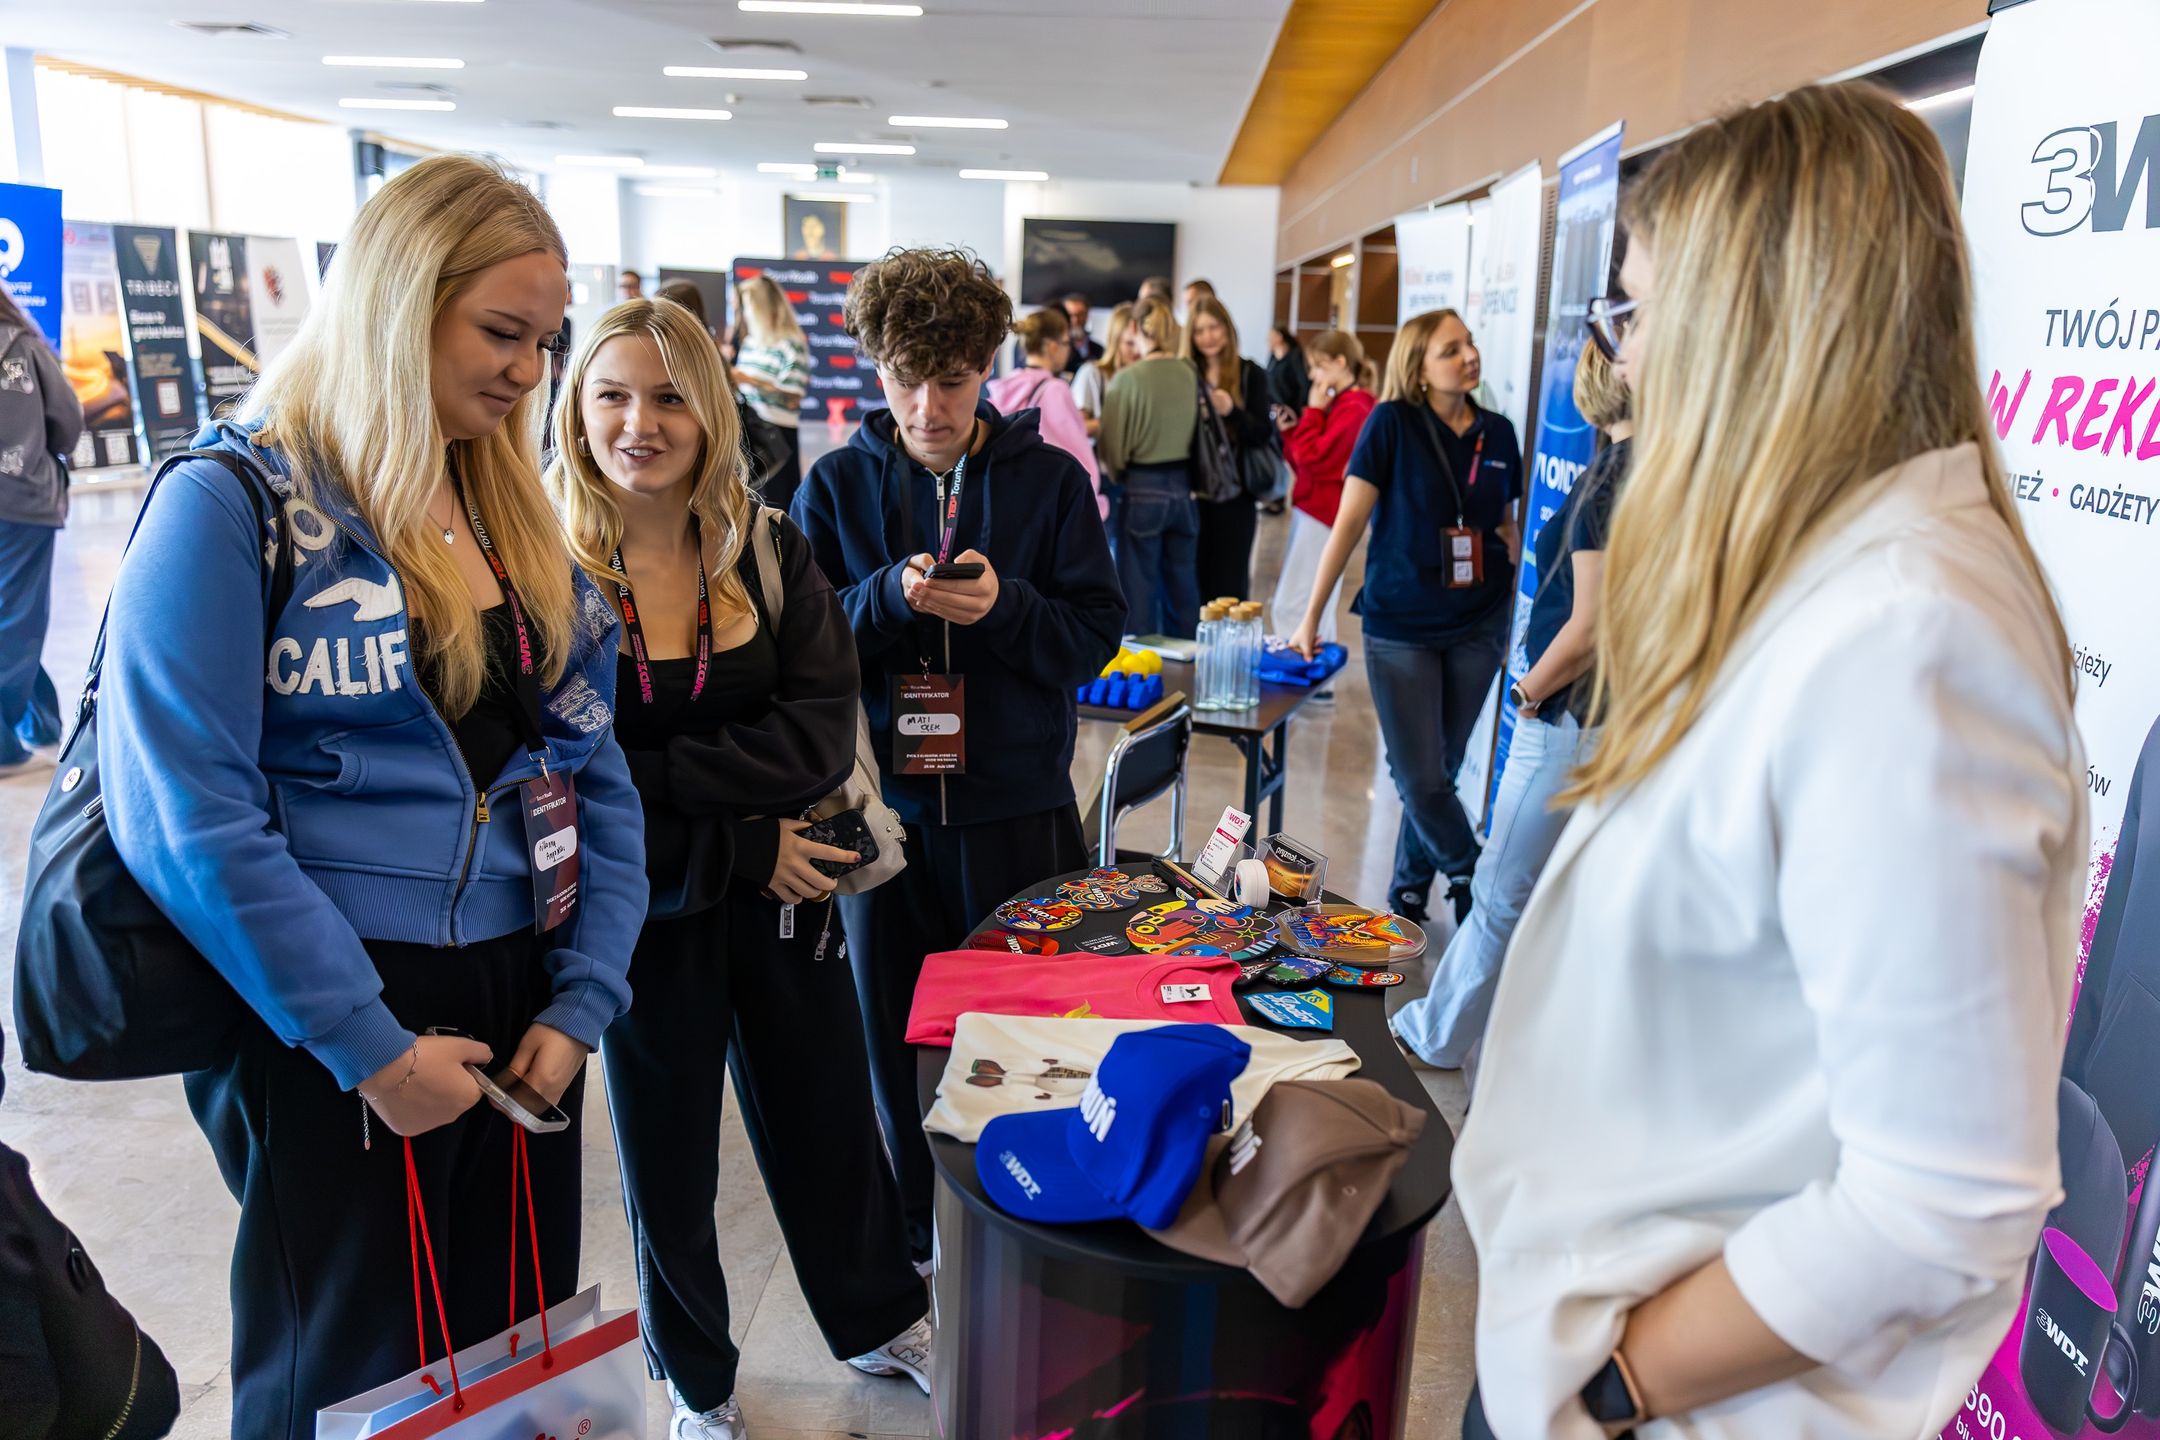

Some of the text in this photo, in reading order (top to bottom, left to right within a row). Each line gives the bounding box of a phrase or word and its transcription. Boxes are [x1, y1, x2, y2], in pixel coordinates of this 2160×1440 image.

[2046, 297, 2160, 351] TWÓJ P
[1986, 368, 2032, 441] W
[2069, 483, 2160, 525] GADŻETY
[266, 629, 407, 698] CALIF
[2036, 1307, 2089, 1368] 3WDT
